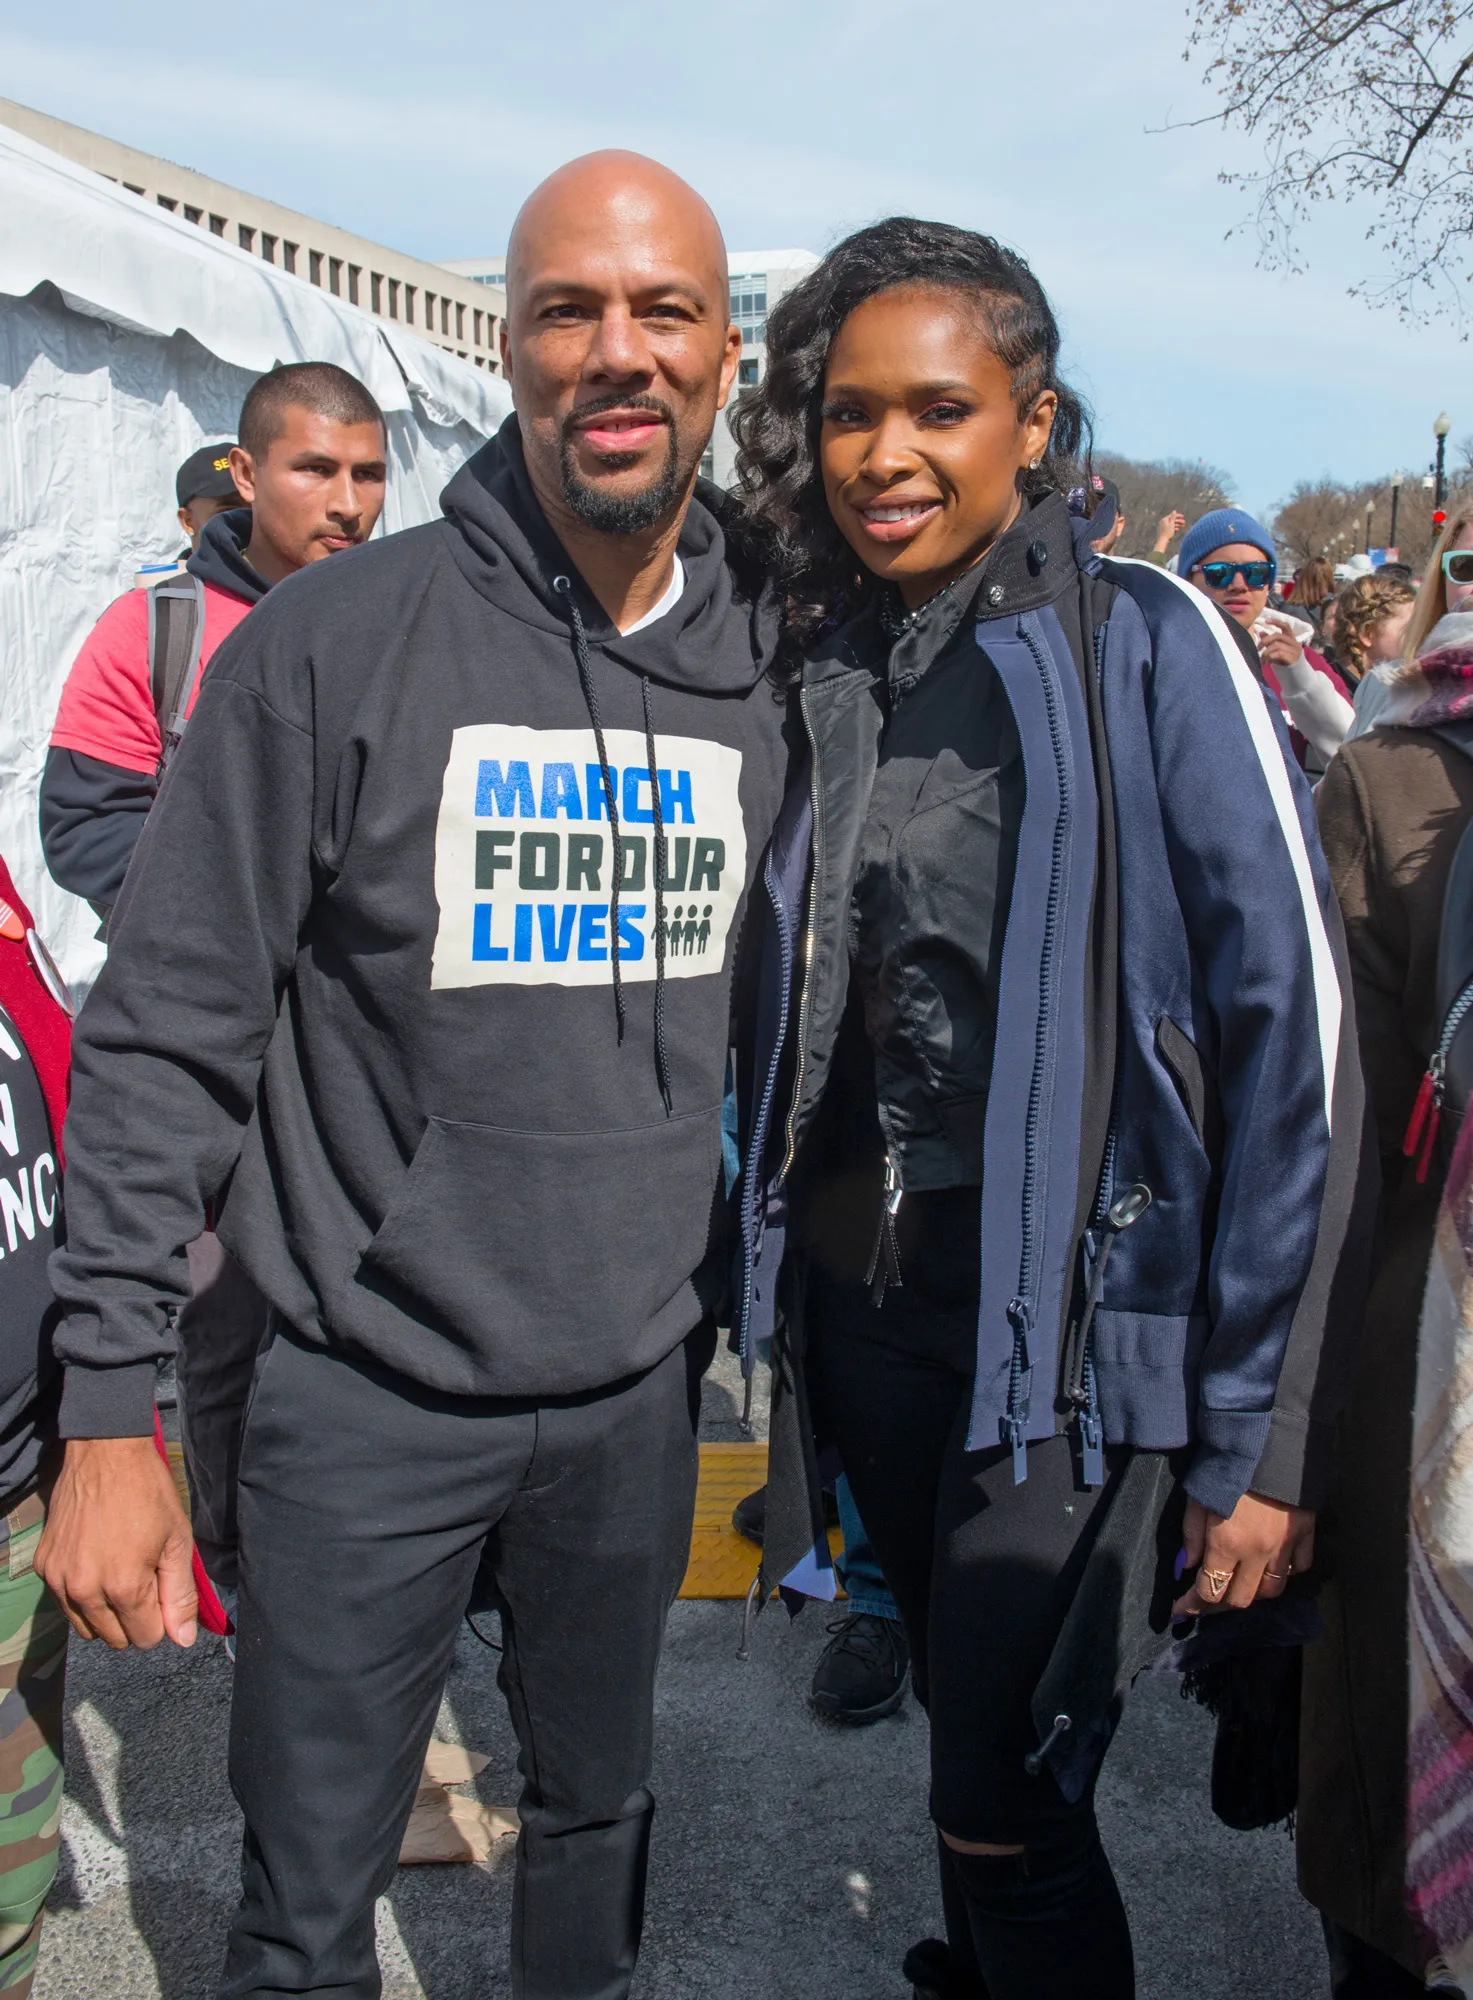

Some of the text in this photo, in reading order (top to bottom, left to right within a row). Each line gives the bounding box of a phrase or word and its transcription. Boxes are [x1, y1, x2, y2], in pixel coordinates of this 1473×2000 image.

[213, 457, 230, 471] SE
[474, 759, 695, 824] MARCH
[474, 830, 726, 892] FOR OUR
[472, 903, 647, 962] LIVES
[0, 1152, 56, 1260] NC
